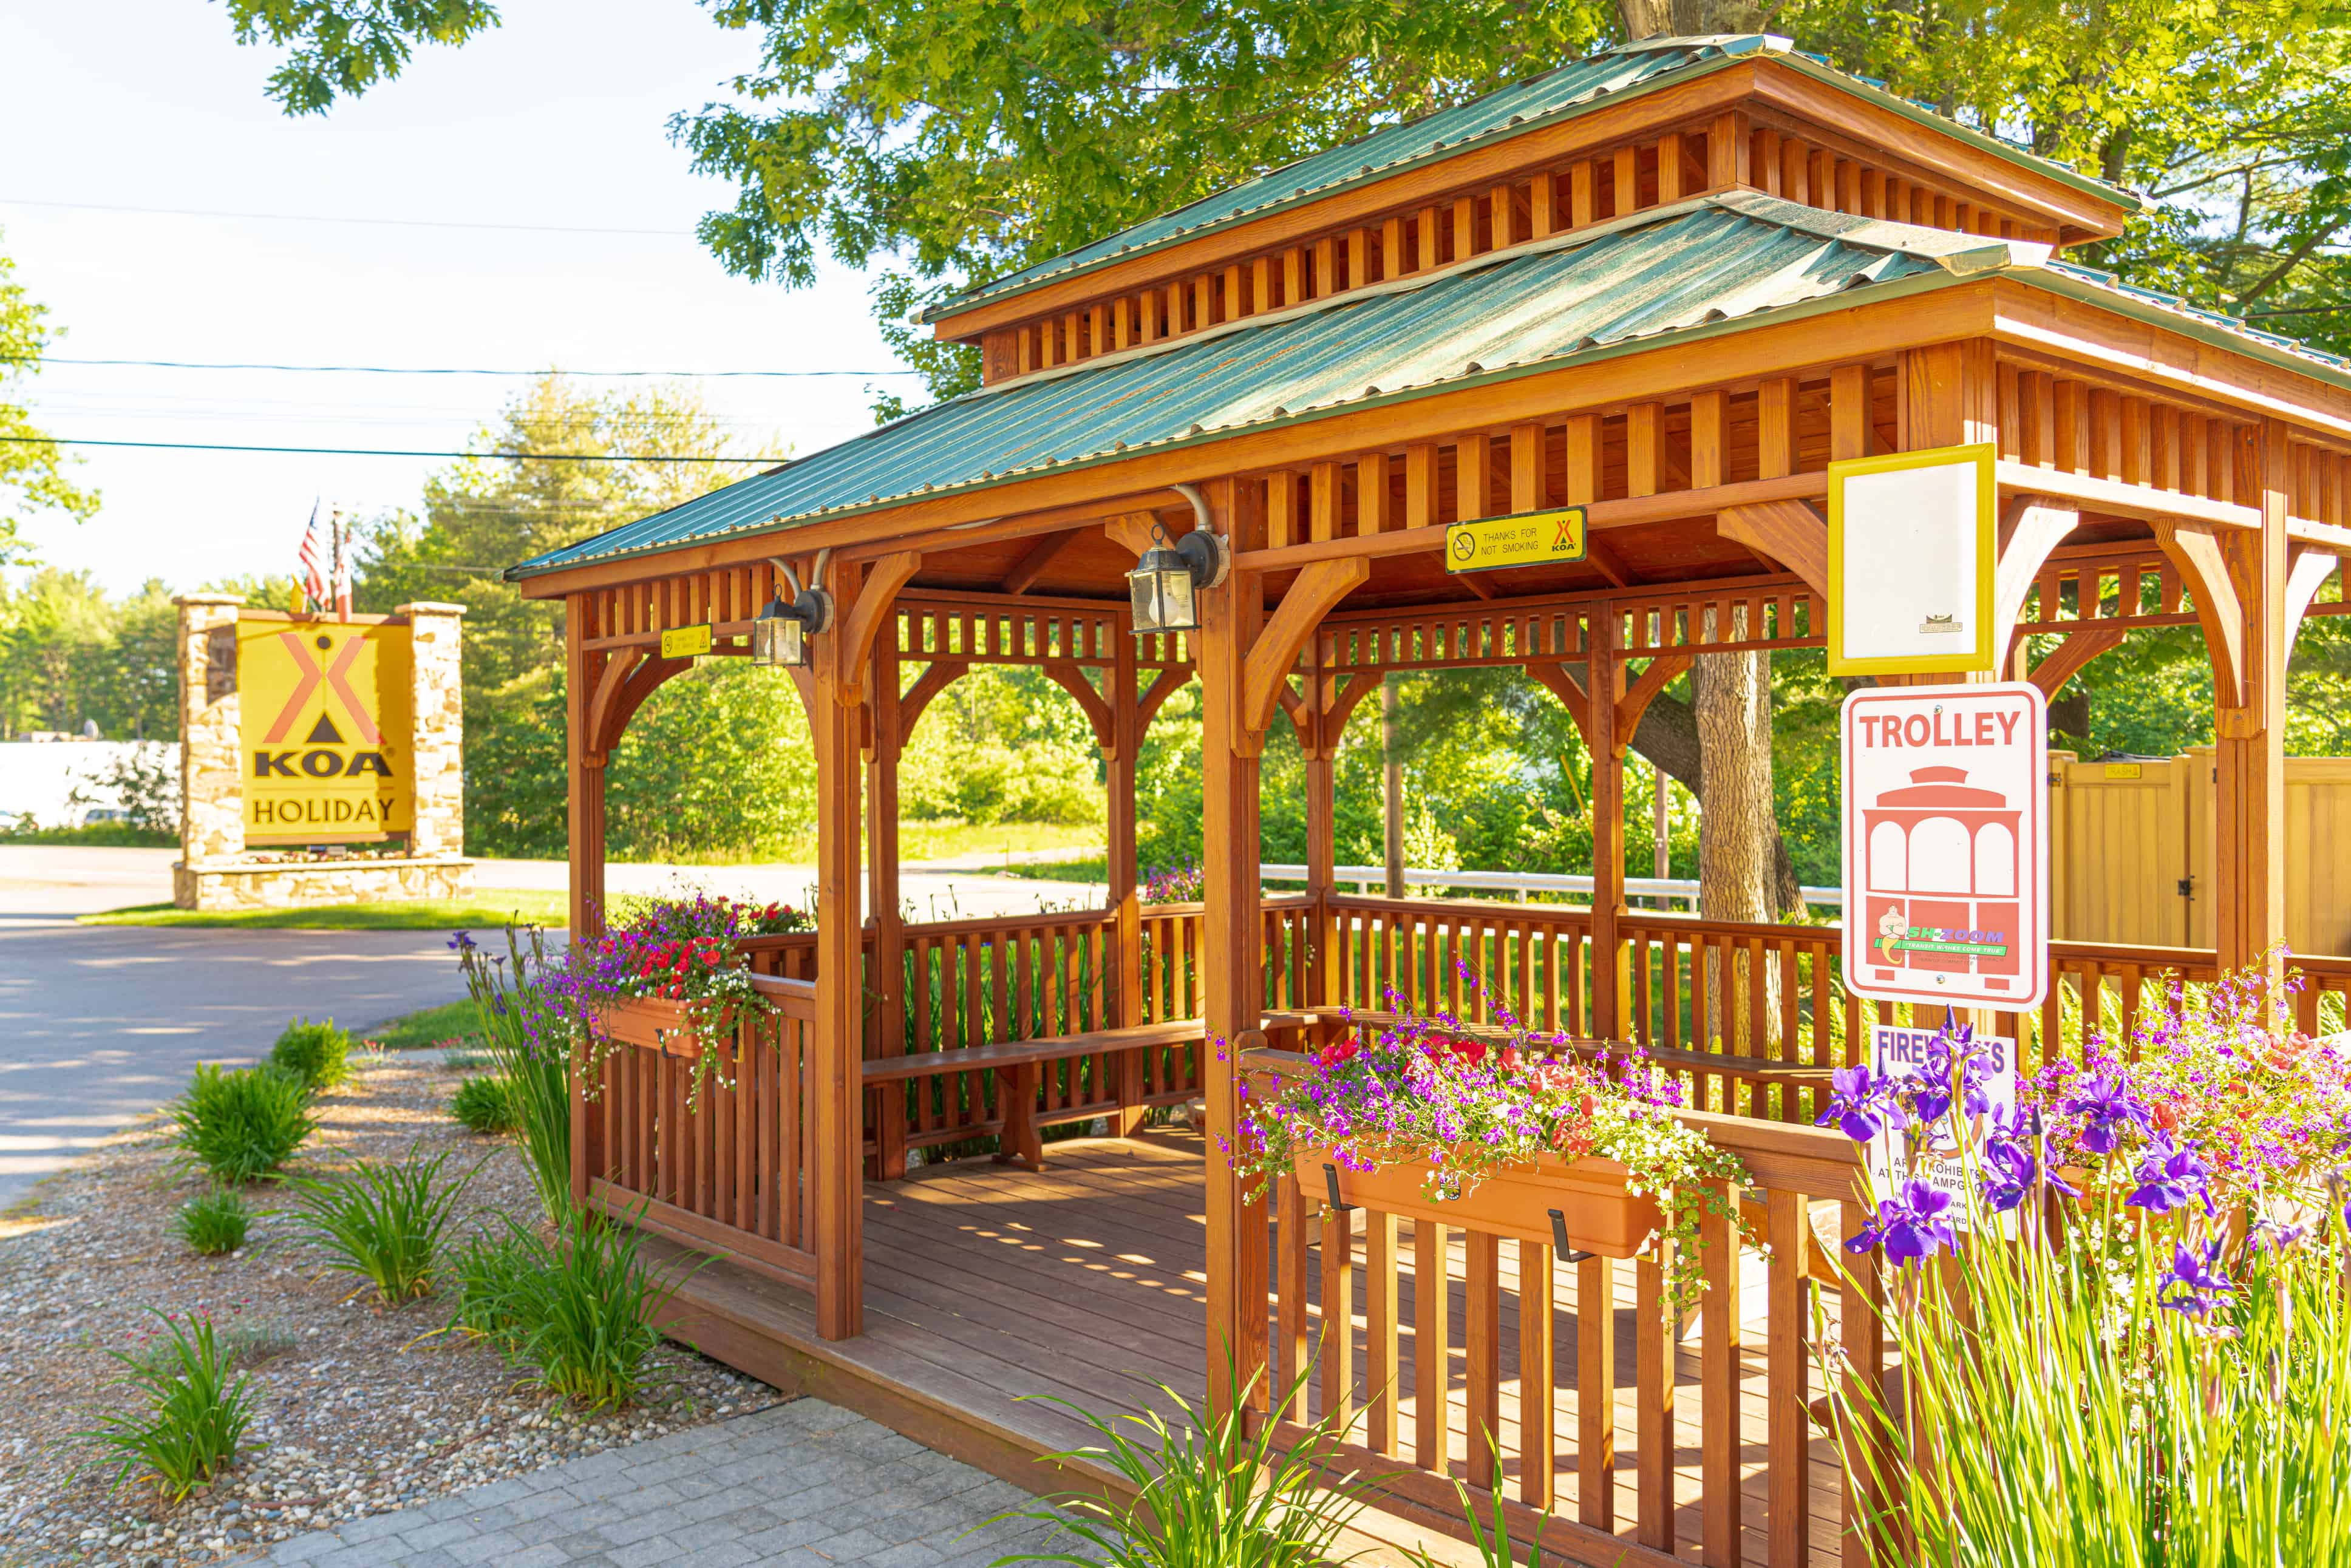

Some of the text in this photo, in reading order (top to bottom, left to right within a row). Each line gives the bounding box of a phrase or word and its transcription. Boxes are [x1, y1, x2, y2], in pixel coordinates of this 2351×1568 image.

[1483, 528, 1537, 542] THANKS FOR
[1481, 540, 1539, 555] NOT SMOKING
[1552, 543, 1575, 552] KOA
[1859, 711, 2021, 748] TROLLEY
[254, 750, 393, 778] KOA
[254, 798, 395, 823] HOLIDAY
[1877, 1030, 2004, 1073] FIRES
[1895, 1170, 1919, 1181] THS
